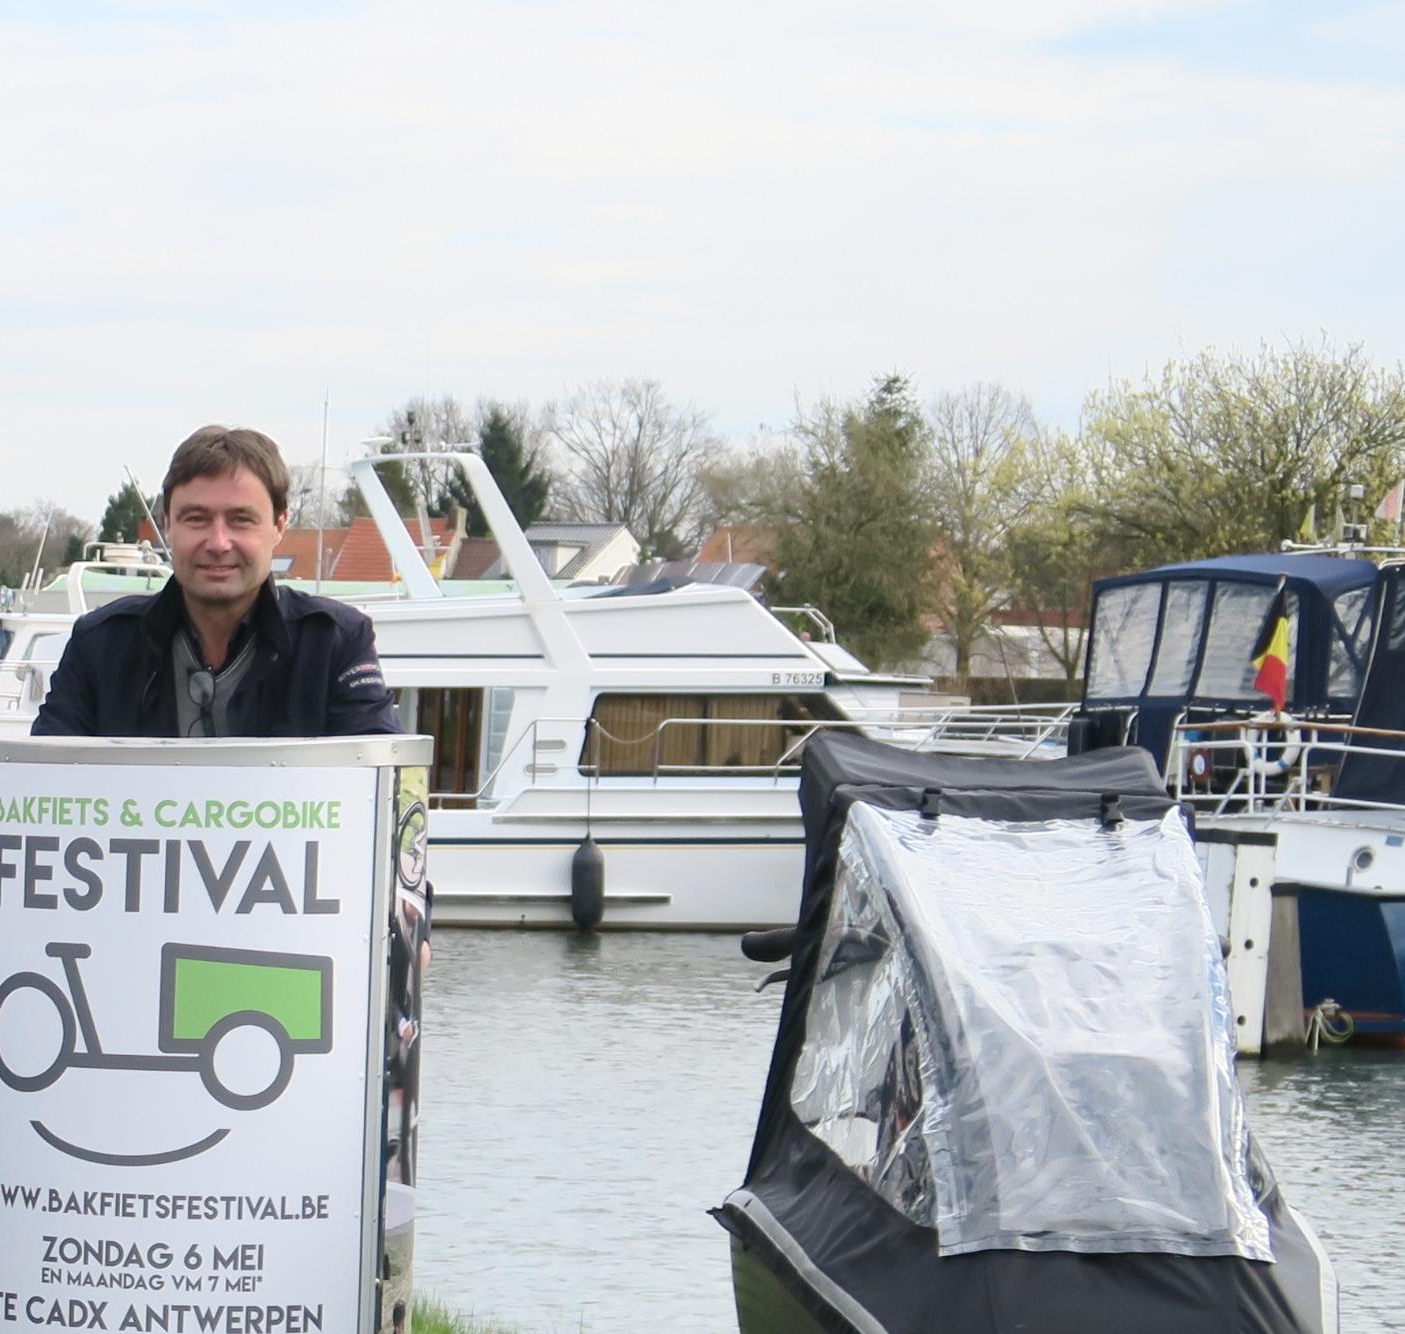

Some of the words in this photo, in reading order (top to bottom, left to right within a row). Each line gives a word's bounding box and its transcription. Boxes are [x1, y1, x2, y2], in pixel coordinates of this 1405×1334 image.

[772, 673, 781, 684] B
[785, 673, 822, 684] 76325
[120, 798, 143, 827] &
[154, 799, 342, 829] CARGOBIKE
[42, 1235, 174, 1270] ZONDAG
[183, 1243, 202, 1270] 6
[213, 1244, 264, 1271] MEI
[42, 1267, 62, 1284] EN
[67, 1270, 165, 1291] MAANDAG
[171, 1274, 202, 1292] VM
[208, 1276, 219, 1292] 7
[25, 1295, 109, 1330] CADX
[119, 1304, 323, 1334] ANTWERPEN
